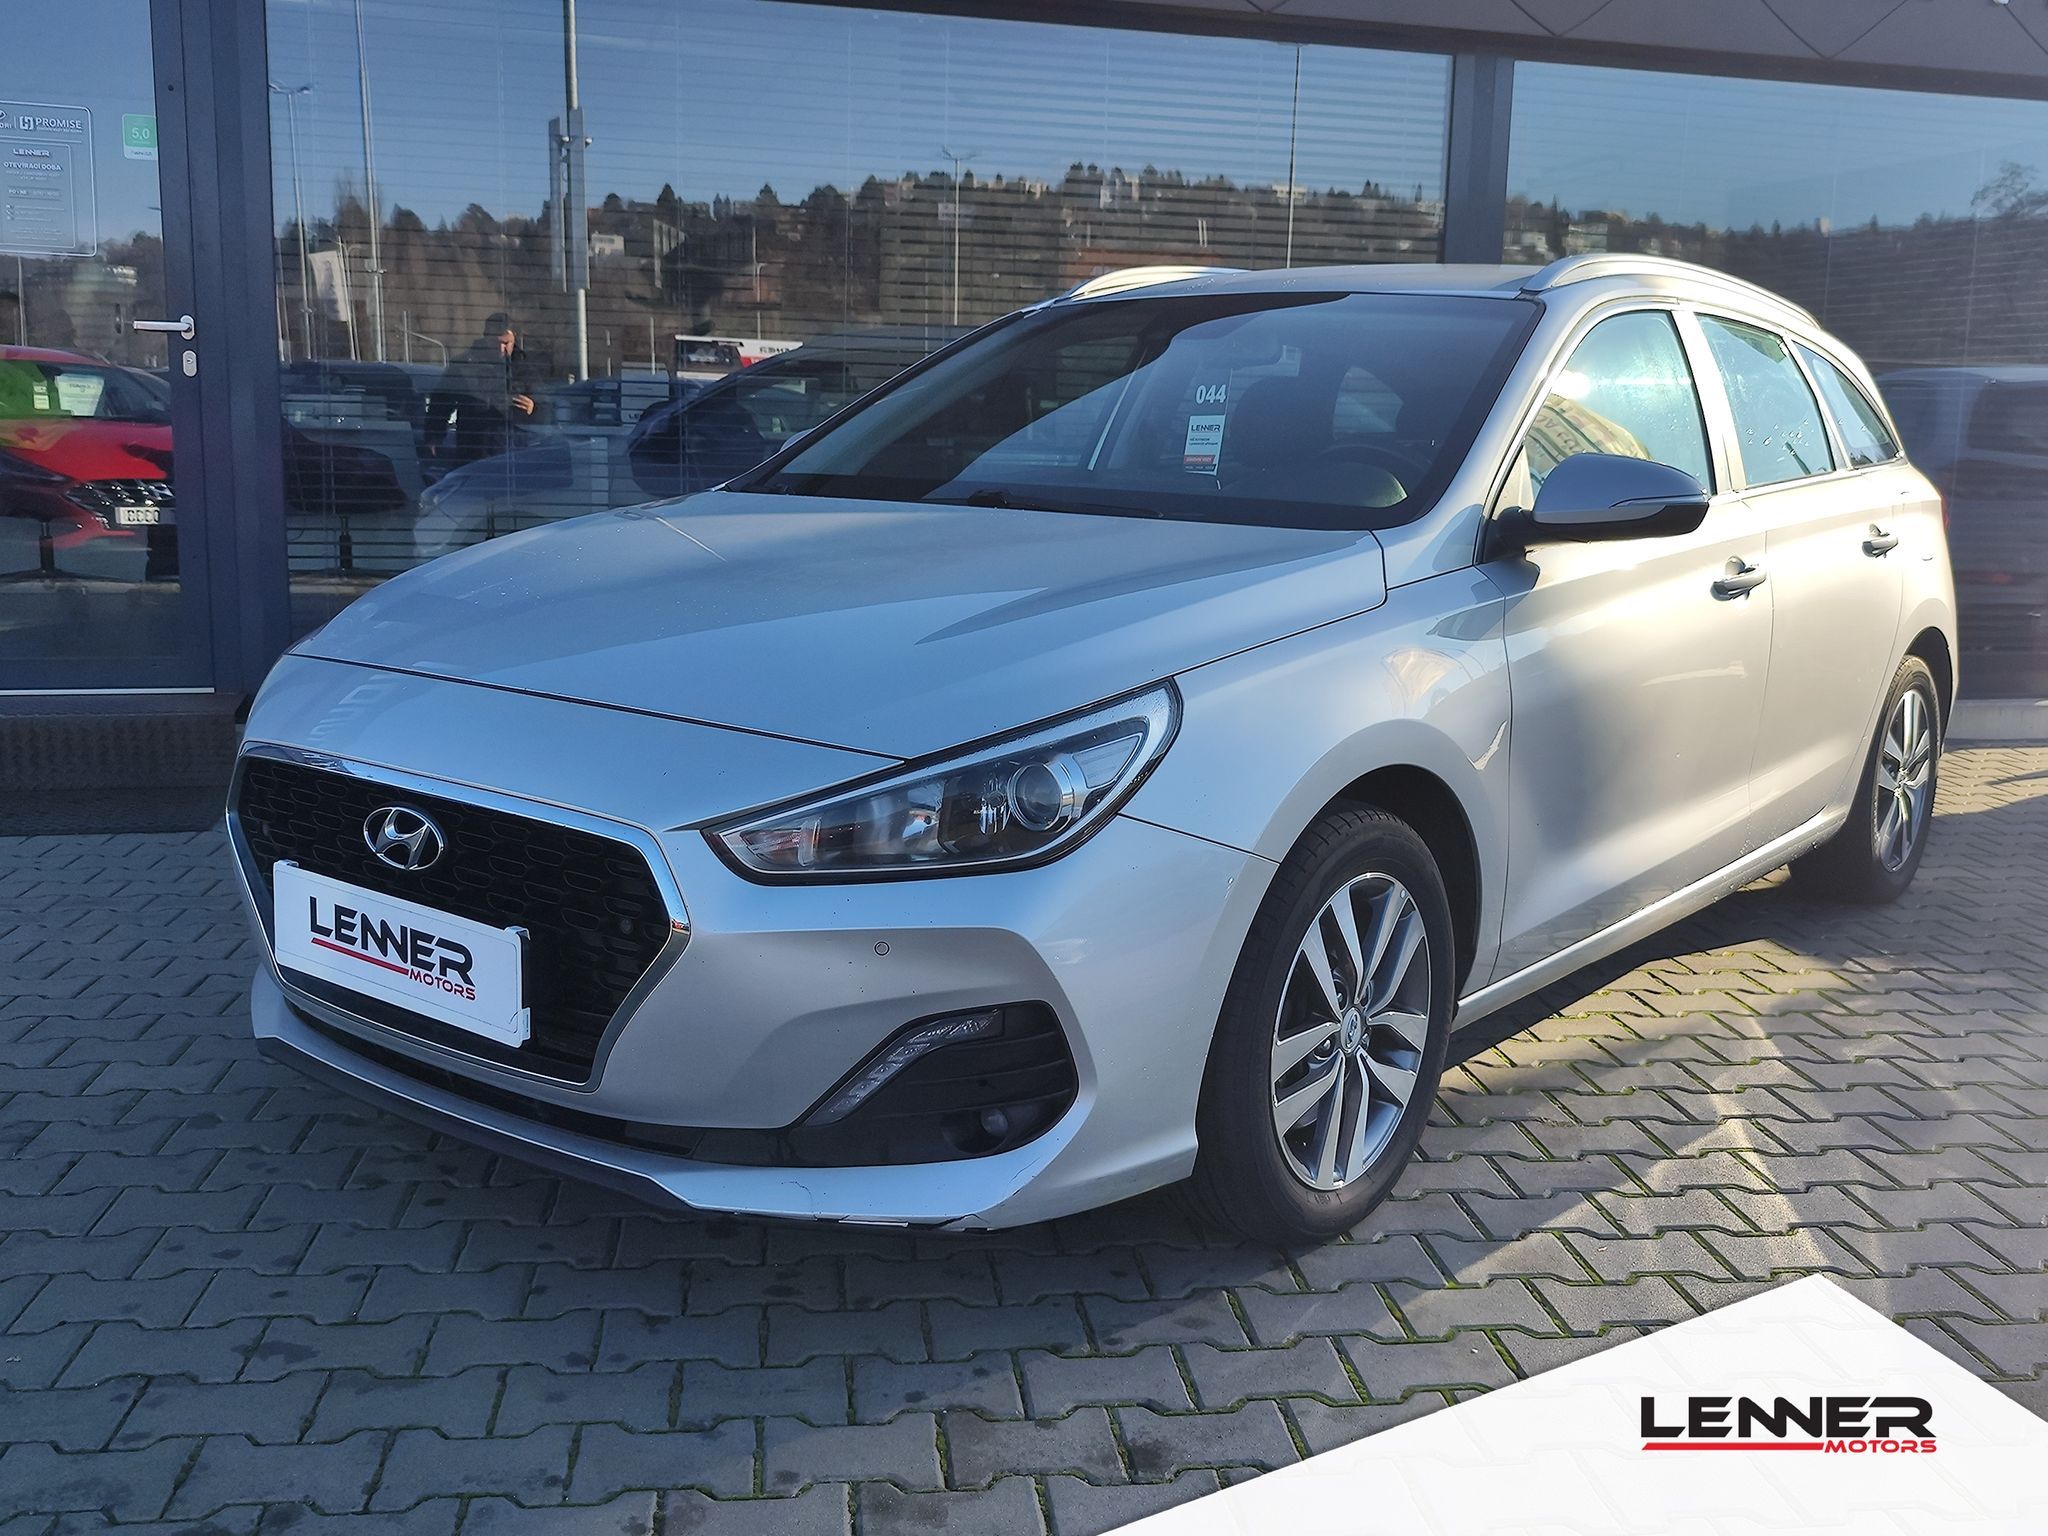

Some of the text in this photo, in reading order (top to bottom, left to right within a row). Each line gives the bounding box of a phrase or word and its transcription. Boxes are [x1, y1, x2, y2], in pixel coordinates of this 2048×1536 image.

[35, 117, 82, 129] PROMISE
[13, 148, 51, 157] LENNER
[1195, 384, 1227, 405] 044
[1190, 424, 1221, 432] LENNER
[309, 895, 476, 987] LENNER
[409, 967, 476, 1001] MOTORS
